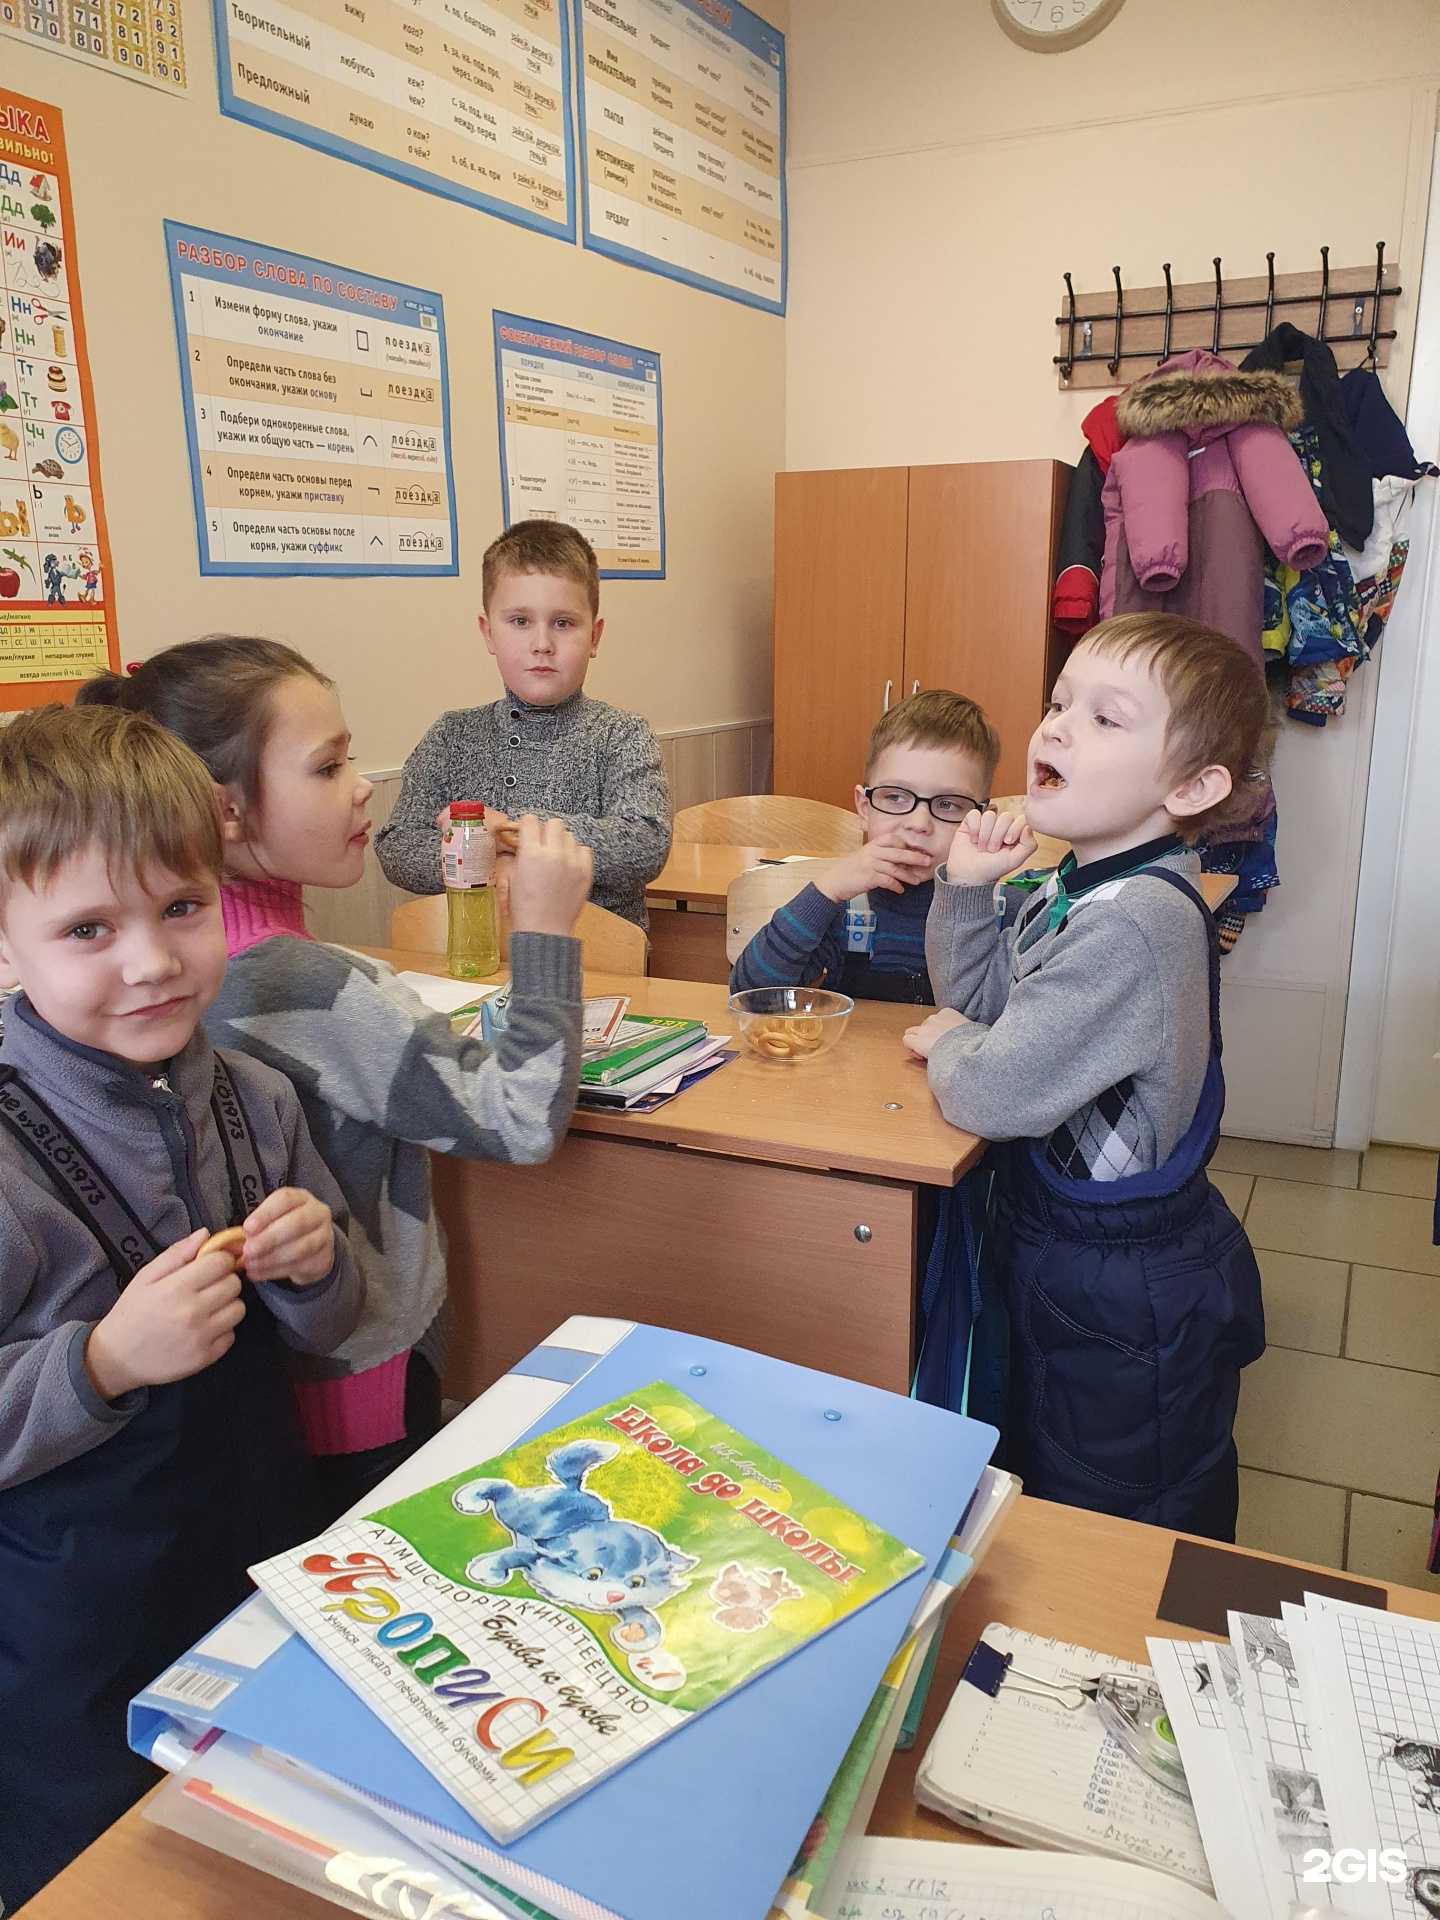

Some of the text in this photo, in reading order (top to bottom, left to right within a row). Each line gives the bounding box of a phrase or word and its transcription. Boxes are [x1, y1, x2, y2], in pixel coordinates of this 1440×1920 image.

[75, 9, 99, 29] 7 1
[116, 3, 140, 23] 7 2
[169, 3, 177, 16] 3
[1050, 5, 1064, 23] 6
[31, 16, 58, 36] 7 0
[118, 25, 140, 44] 8 1
[155, 19, 178, 38] 8 2
[231, 3, 312, 51] Творительный
[77, 32, 102, 52] 8 0
[157, 41, 178, 60] 9 1
[120, 48, 143, 67] 9 0
[340, 55, 376, 79] любуюсь
[157, 62, 181, 82] 10 0
[237, 62, 311, 105] Предложный
[2, 194, 25, 219] Дд
[4, 231, 26, 250] Ии
[176, 239, 398, 312] РАЗБОР СЛОВА ПО СОСТАВУ
[11, 296, 32, 315] Нн
[189, 290, 195, 302] 1
[214, 295, 338, 333] Измени форму слова, укажи
[14, 328, 36, 346] Нн
[258, 325, 304, 343] окончание
[385, 336, 432, 355] поездка
[194, 349, 201, 362] 2
[17, 359, 34, 376] Тт
[226, 355, 337, 385] Определи часть слова без
[229, 376, 337, 404] окончания, укажи основу
[388, 383, 434, 401] поездка
[21, 391, 38, 409] Тт
[200, 408, 207, 420] 3
[25, 422, 45, 440] Чч
[220, 410, 350, 438] Подбери однокоренные слова,
[217, 429, 355, 454] укажи их общую часть корень
[391, 434, 436, 450] поездка
[206, 465, 212, 477] 4
[227, 466, 352, 489] Определи часть основы перед
[239, 487, 345, 504] корнем, укажи приставку
[395, 490, 440, 503] поездка
[211, 521, 218, 532] 5
[233, 521, 356, 538] Определи часть основы после
[250, 541, 343, 554] корня, укажи суффикс
[399, 535, 444, 551] поездка
[361, 1647, 393, 1677] писать
[394, 1679, 450, 1734] печатными
[451, 1737, 498, 1786] буквами
[558, 1686, 623, 1737] букве
